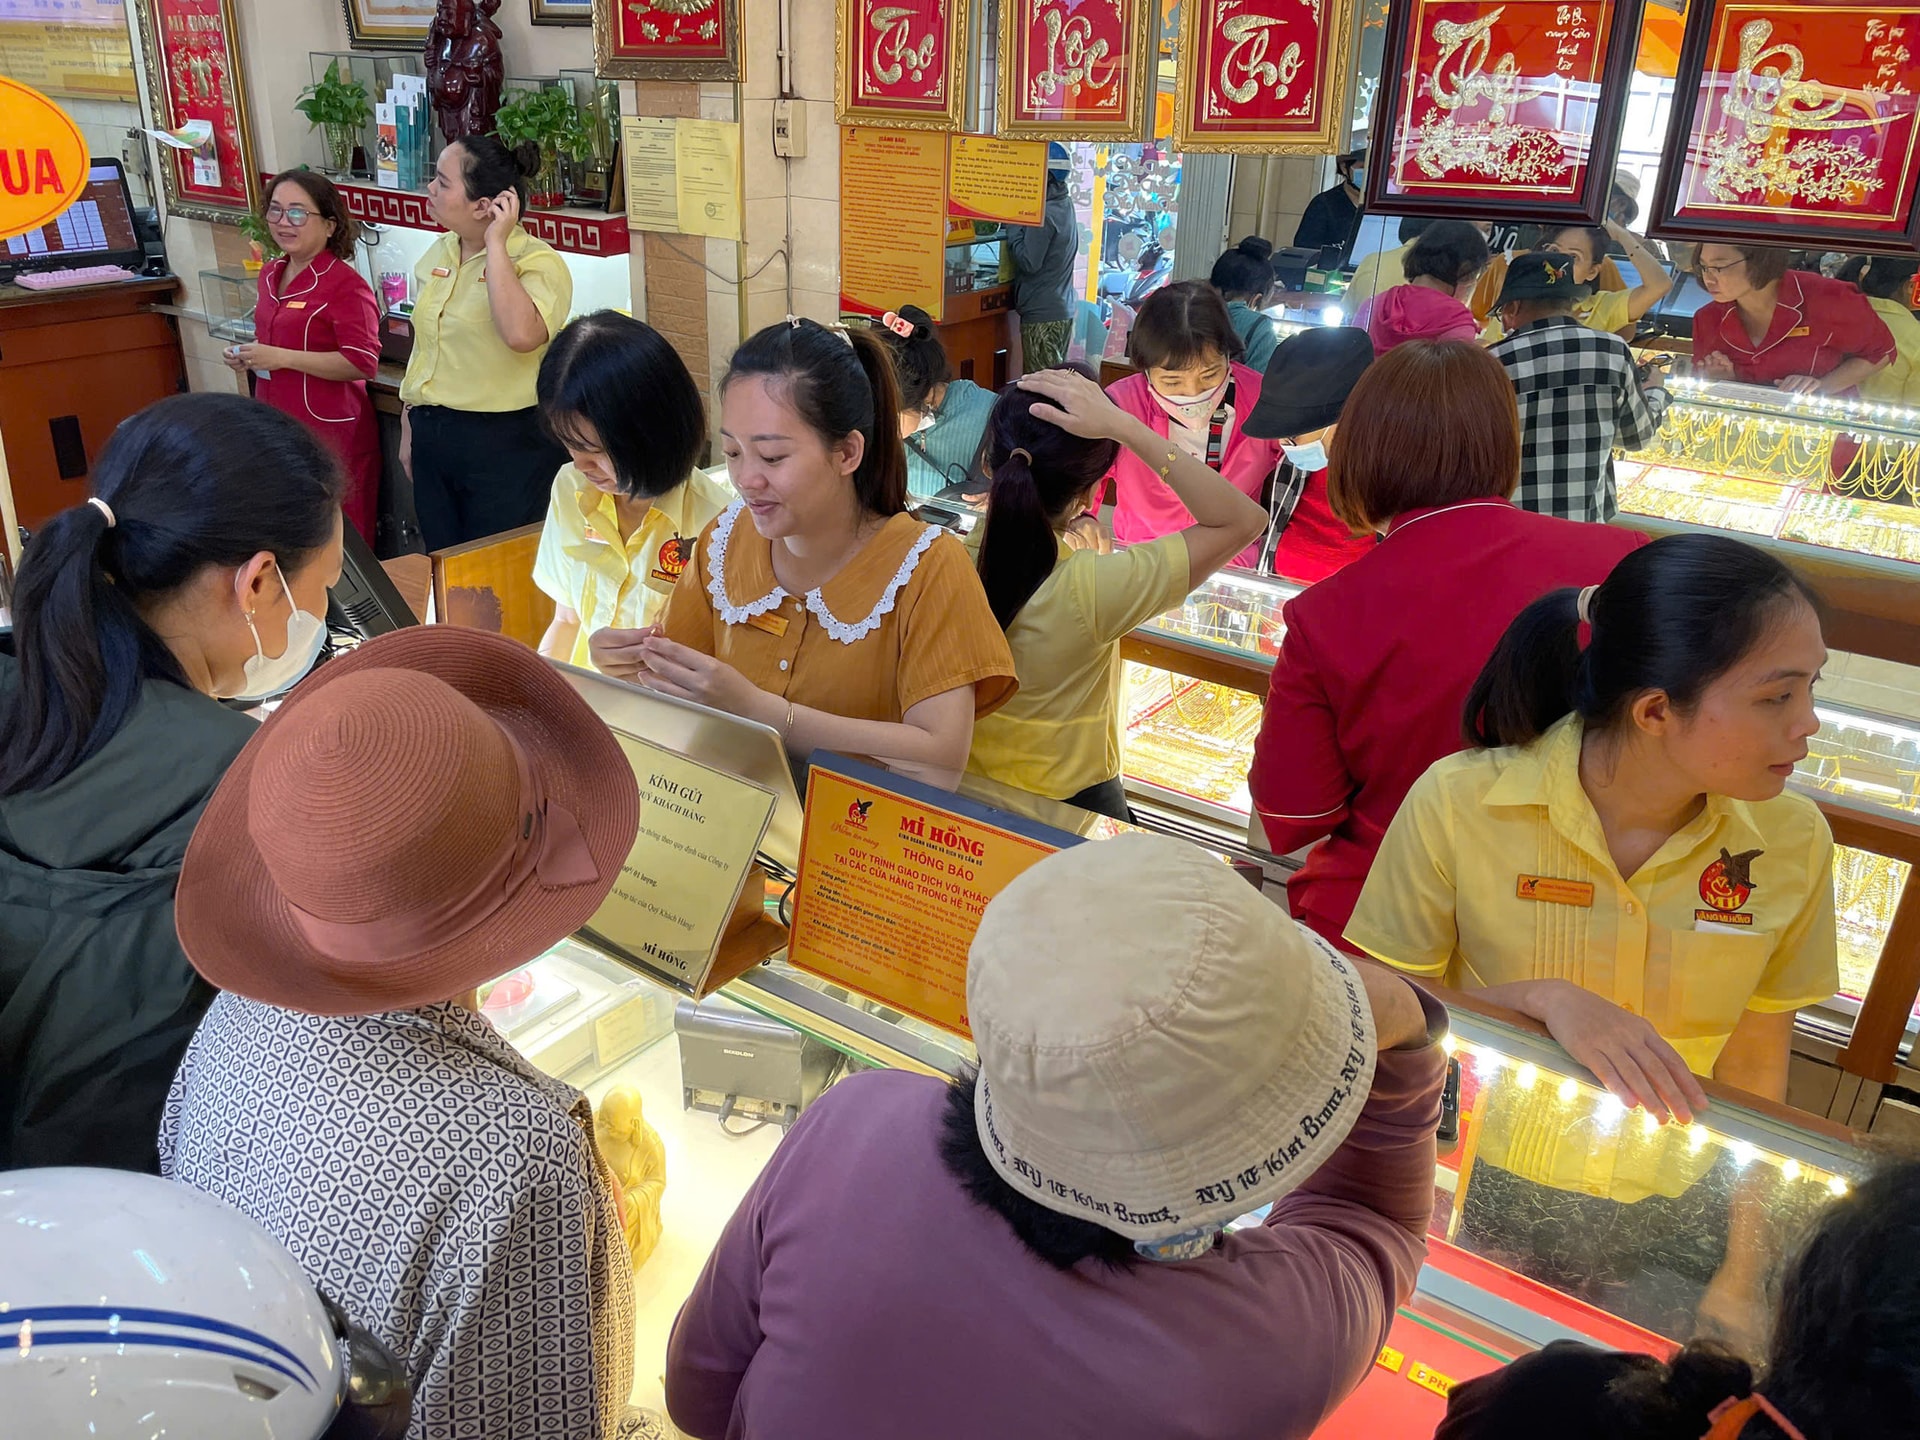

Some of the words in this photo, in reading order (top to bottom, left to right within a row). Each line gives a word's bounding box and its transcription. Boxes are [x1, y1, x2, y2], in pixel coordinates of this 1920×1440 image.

[871, 7, 936, 85] Thọ
[1036, 8, 1117, 97] Lộc
[1221, 14, 1305, 104] Thọ
[1431, 5, 1543, 123] Thọ
[0, 148, 65, 196] UA
[648, 774, 678, 795] KÍNH
[679, 787, 703, 804] GỬI
[652, 796, 682, 814] KHÁCH
[681, 808, 706, 824] HÀNG
[929, 824, 985, 858] HỒNG
[834, 853, 848, 866] TẠI
[849, 858, 867, 872] CÁC
[869, 864, 887, 881] CỬA
[889, 872, 914, 890] HÀNG
[917, 884, 948, 903] TRONG
[950, 896, 963, 909] HỆ
[966, 900, 985, 917] THỐ
[849, 847, 867, 859] QUY
[869, 853, 895, 871] TRÌNH
[897, 866, 919, 880] GIAO
[921, 872, 943, 888] DỊCH
[945, 881, 961, 896] VỚI
[903, 847, 944, 872] THÔNG
[948, 863, 974, 882] BÁO
[658, 949, 688, 971] HỒNG
[723, 1048, 755, 1058] BIXOLON
[1428, 1375, 1448, 1391] PH
